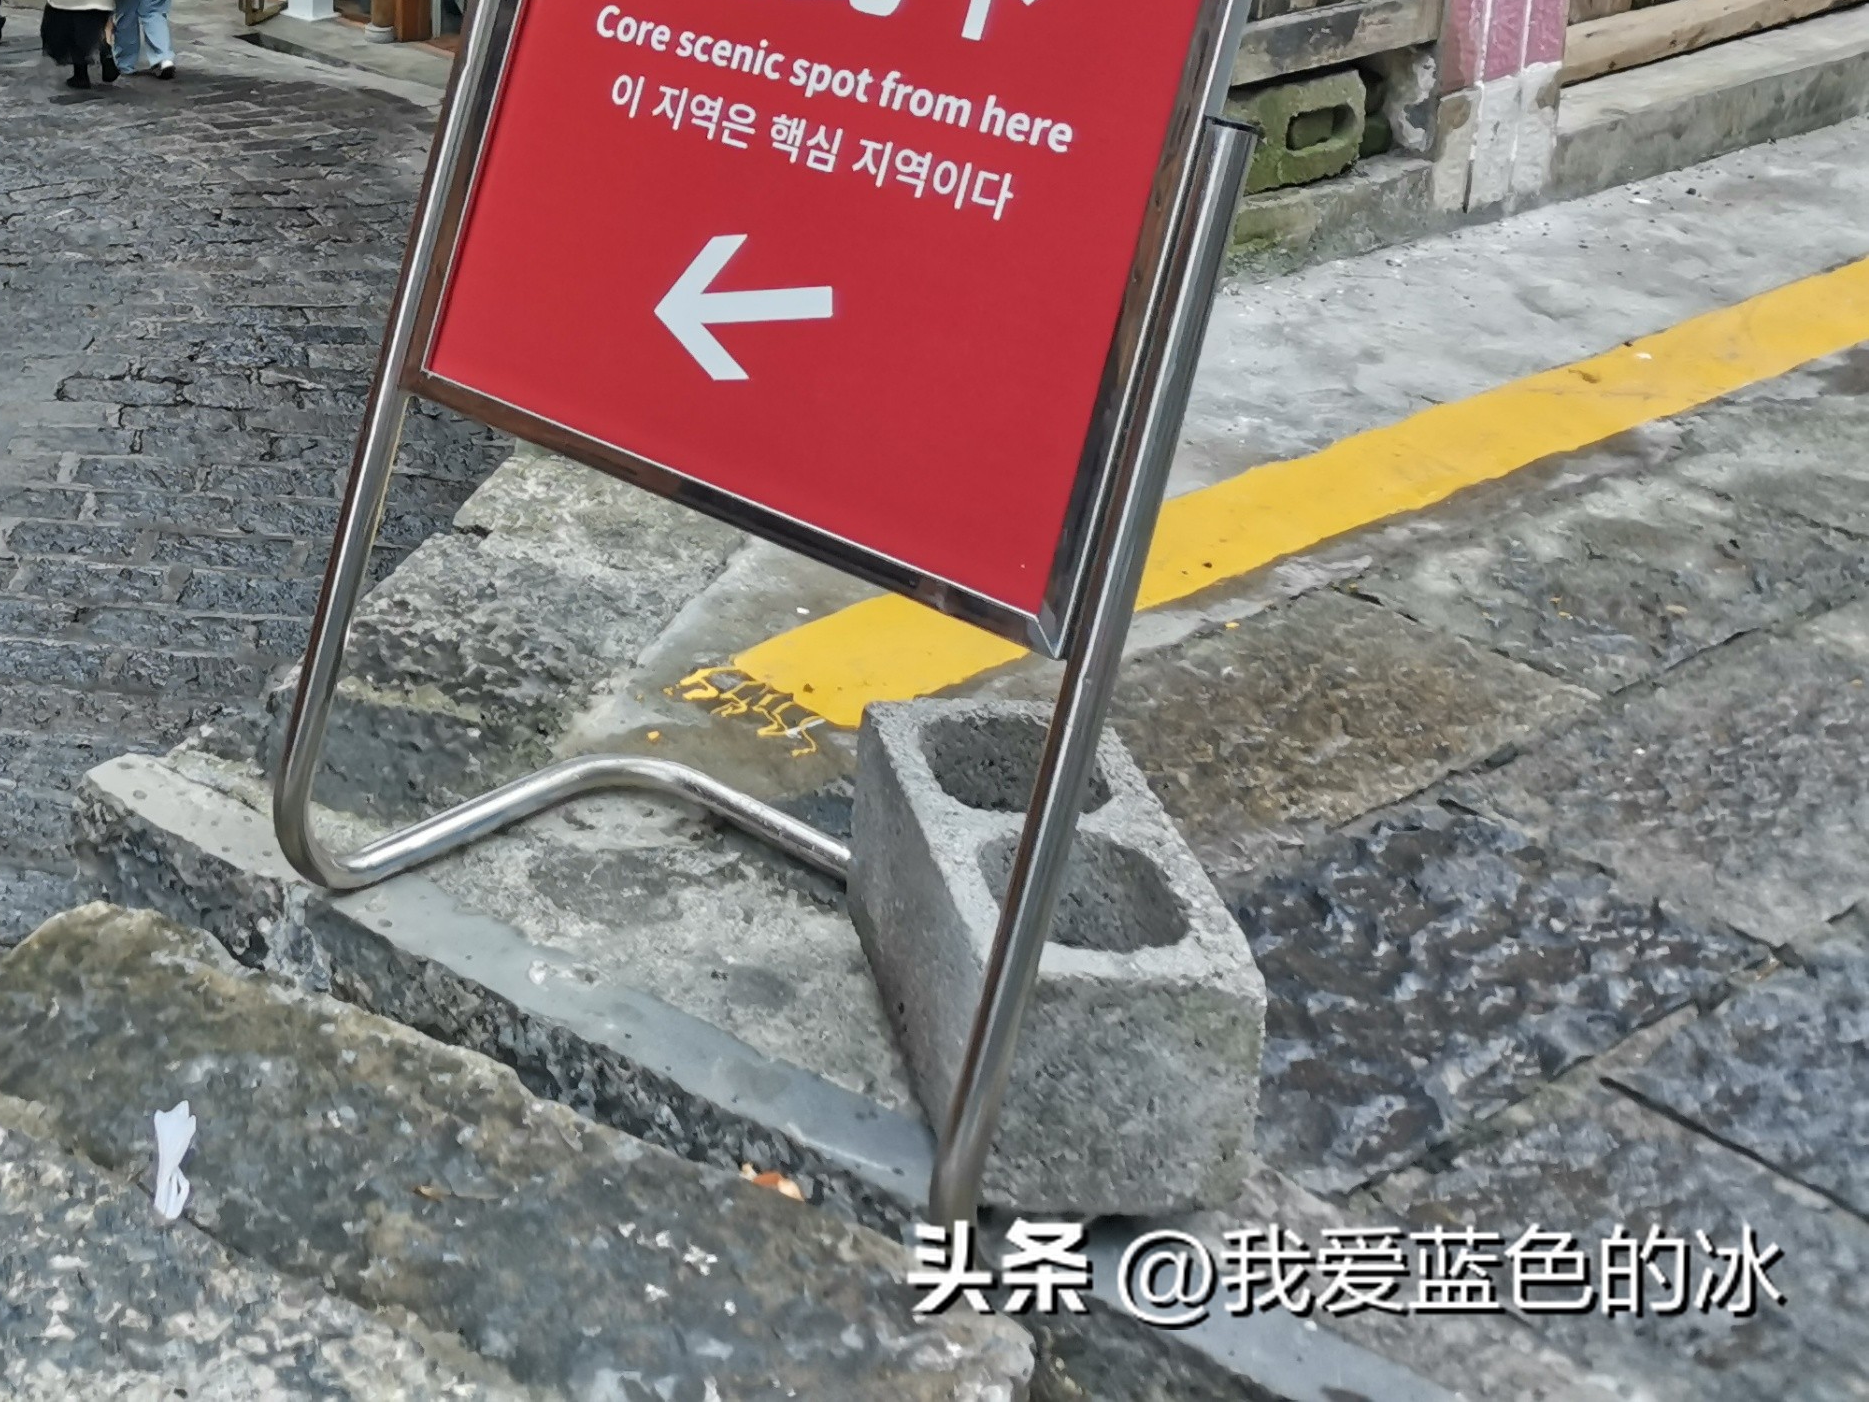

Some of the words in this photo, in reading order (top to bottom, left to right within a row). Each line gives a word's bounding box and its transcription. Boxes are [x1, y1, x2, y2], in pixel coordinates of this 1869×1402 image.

[596, 5, 671, 51] Core
[676, 30, 786, 80] scenic
[789, 58, 874, 98] spot
[879, 71, 973, 127] from
[979, 95, 1074, 153] here
[611, 74, 645, 119] 이
[652, 84, 757, 149] 지역은
[769, 114, 844, 173] 핵심
[852, 138, 1014, 221] 지역이다
